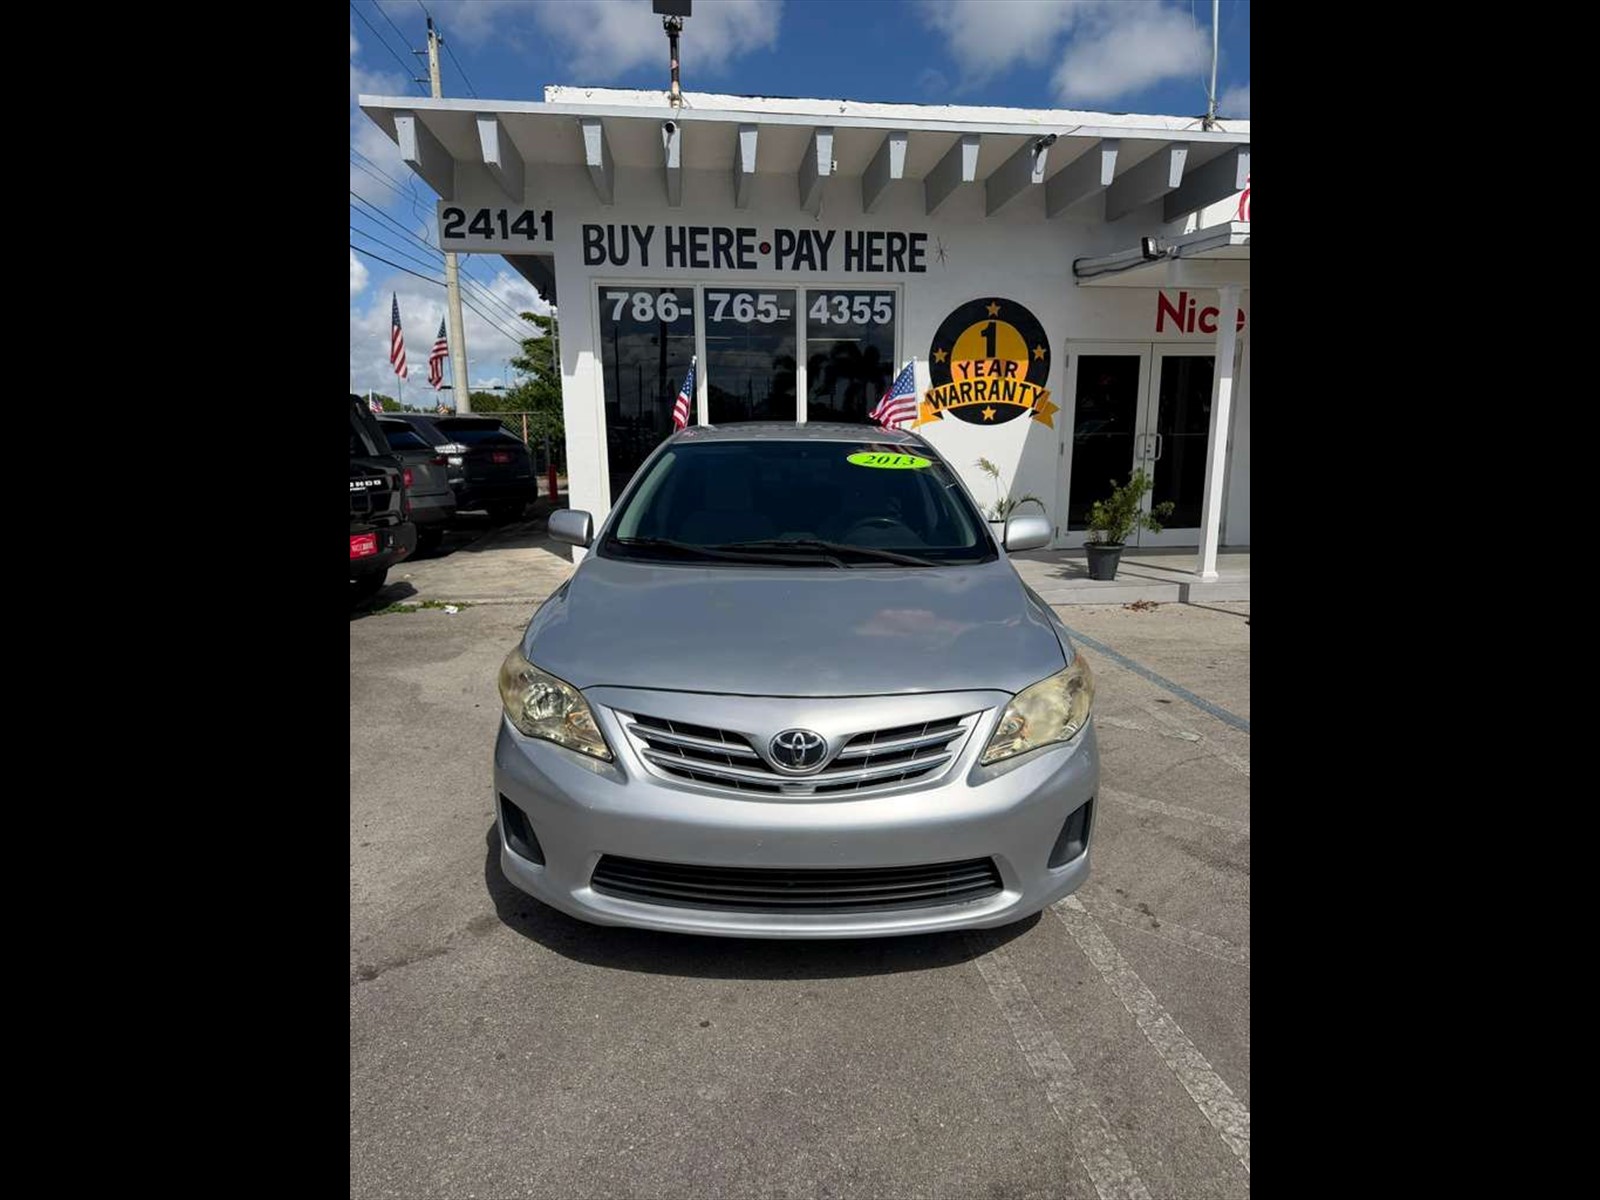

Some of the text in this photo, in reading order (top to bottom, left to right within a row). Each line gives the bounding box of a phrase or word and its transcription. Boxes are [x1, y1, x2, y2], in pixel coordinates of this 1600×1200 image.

[442, 207, 554, 241] 24141
[582, 224, 928, 273] BUY HERE PAY HERE
[606, 292, 892, 324] 786- 765- 4355
[980, 321, 997, 358] 1
[958, 360, 1018, 379] YEAR
[926, 380, 1045, 409] WARRANTY
[863, 455, 915, 465] 2013
